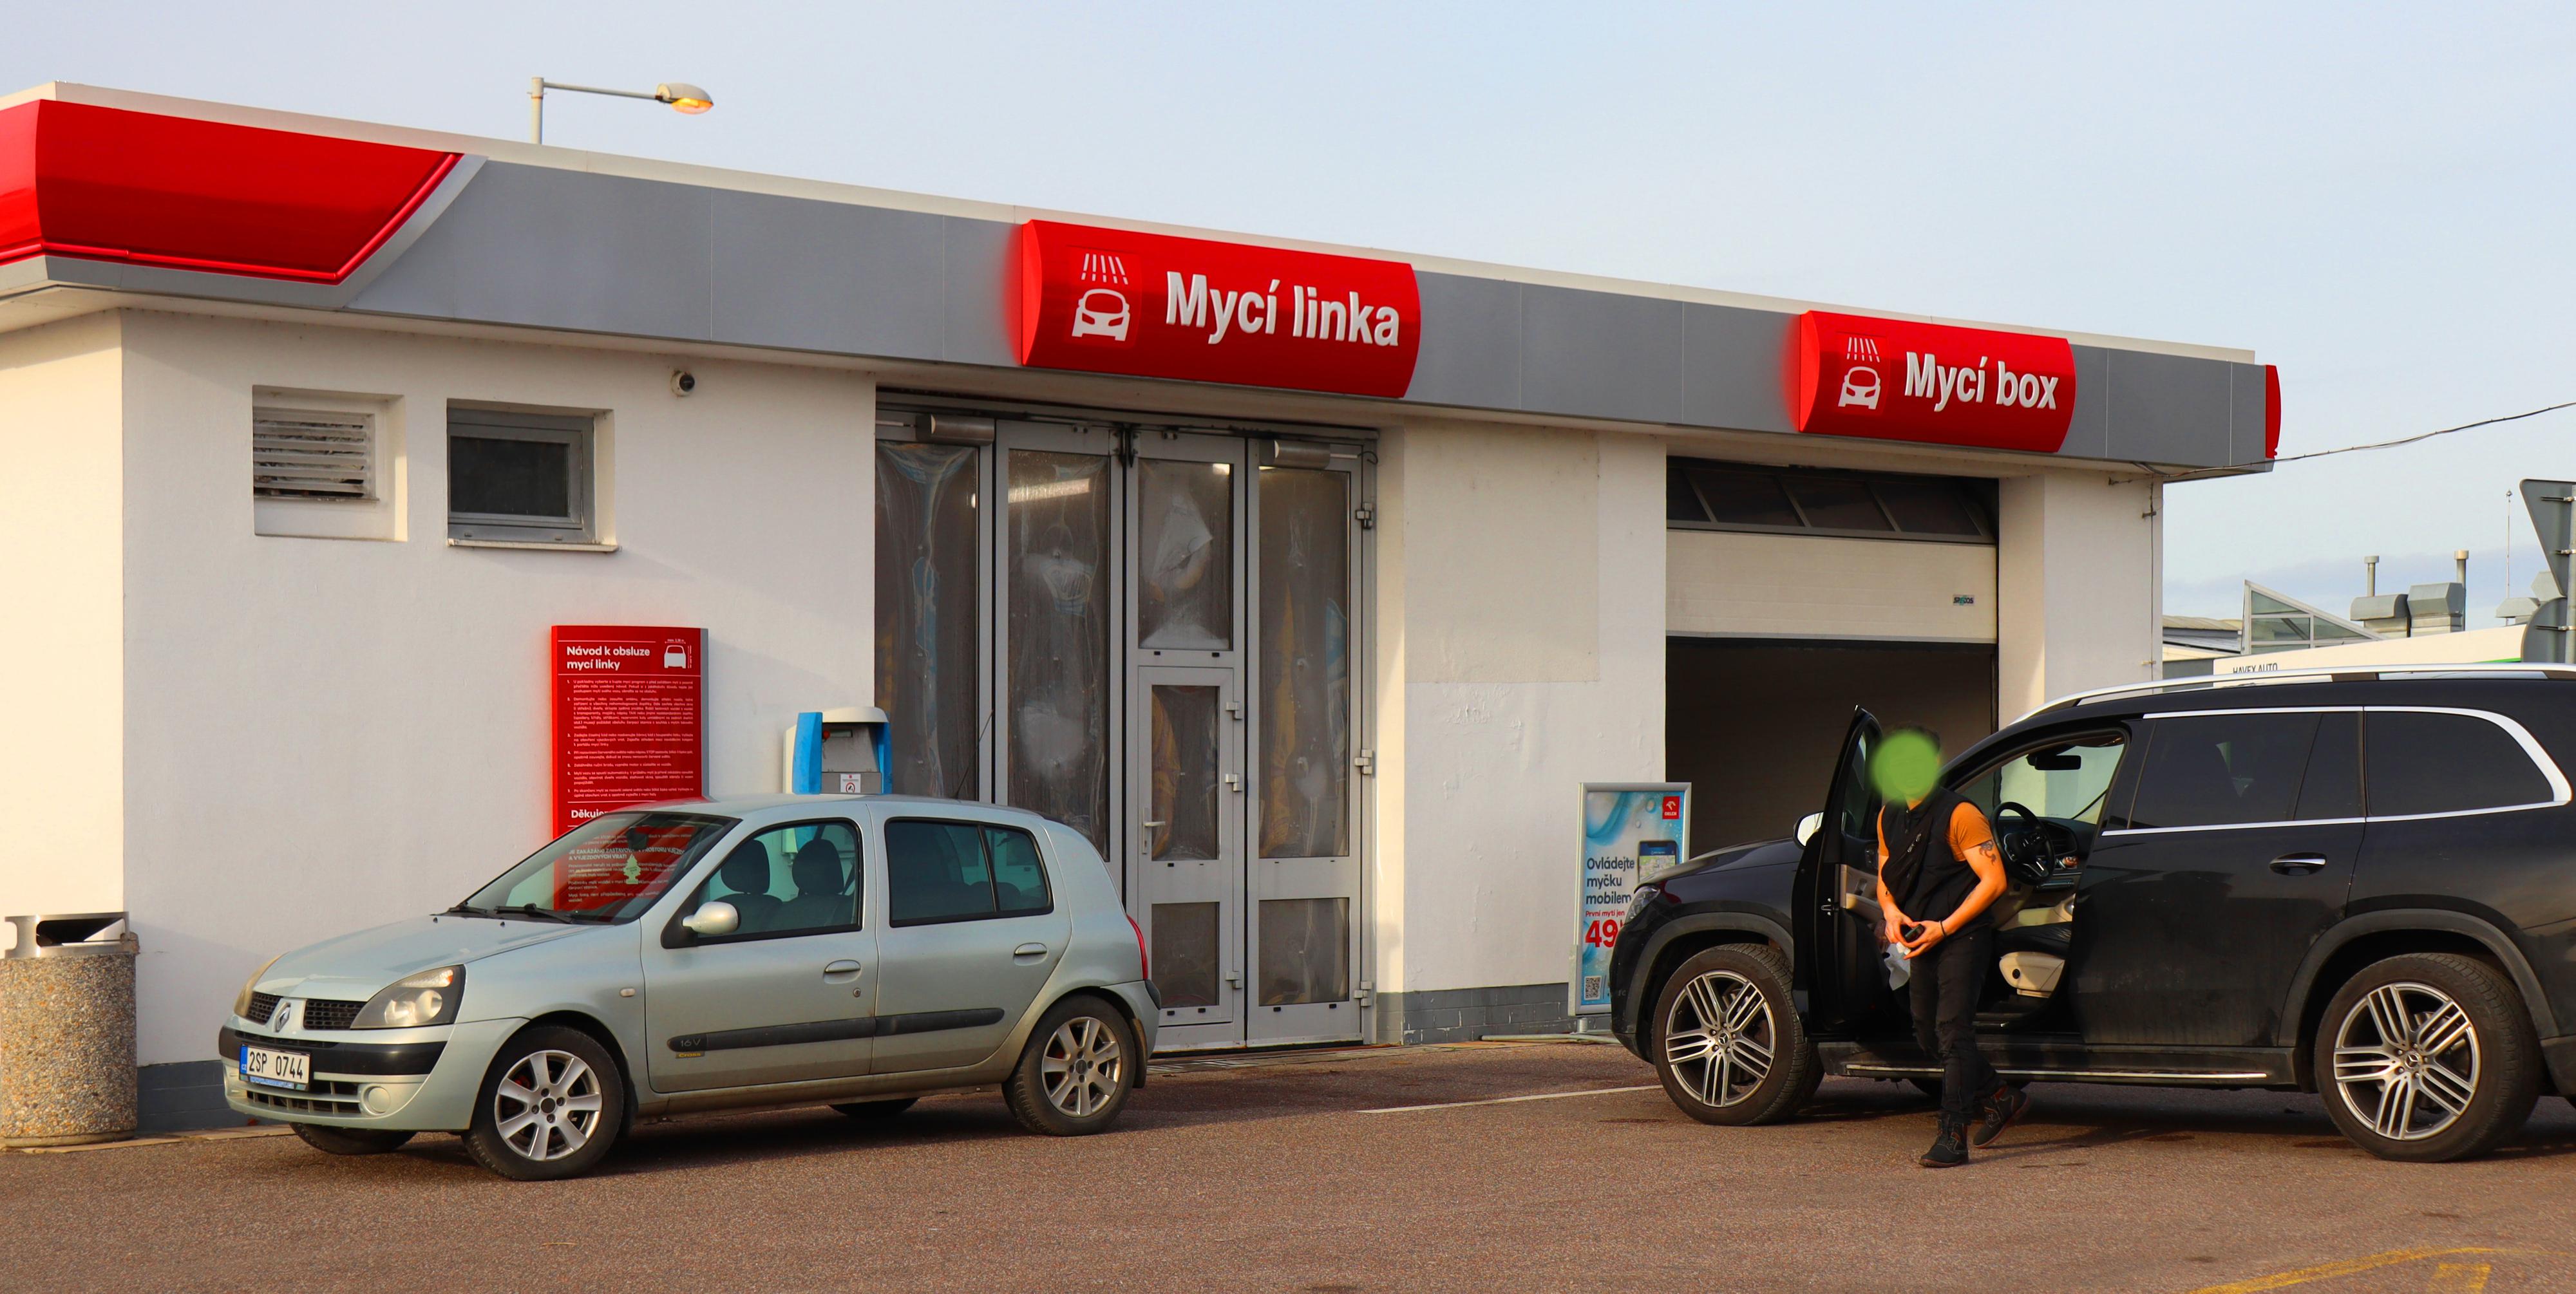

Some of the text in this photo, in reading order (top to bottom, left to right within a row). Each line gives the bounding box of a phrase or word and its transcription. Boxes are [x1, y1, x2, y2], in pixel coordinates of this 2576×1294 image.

[1166, 271, 1399, 347] Mycí linka
[1904, 352, 2059, 411] Mycí box
[567, 646, 650, 657] Návod k obsluze
[567, 659, 620, 671] mycí linky
[2259, 662, 2278, 671] AUTO
[1587, 856, 1634, 872] Ovládejte
[1587, 874, 1622, 890] myčku
[1586, 891, 1632, 905] mobilem
[1602, 909, 1615, 917] mytí
[1616, 909, 1625, 917] jen
[1586, 919, 1618, 948] 49
[680, 1038, 701, 1047] 16V
[249, 1051, 303, 1080] 2SP 0744
